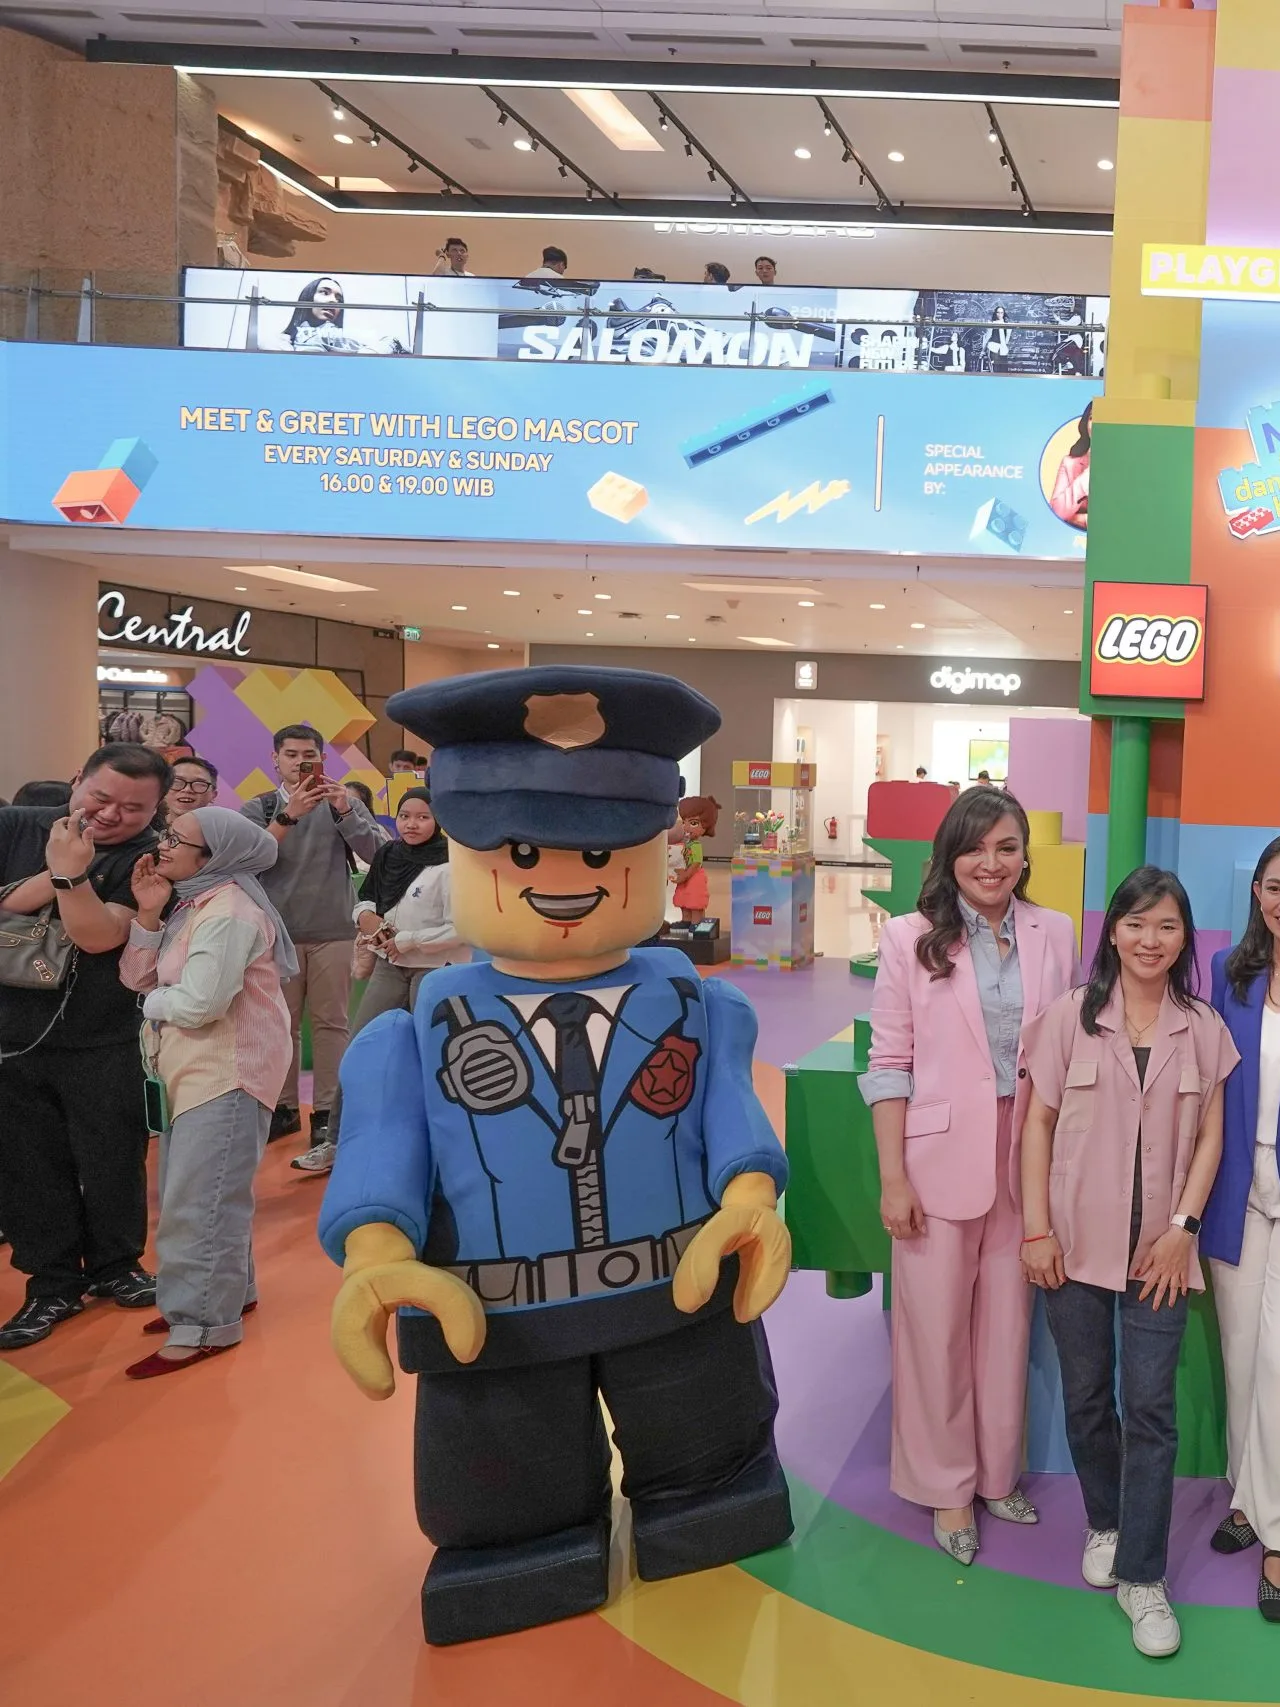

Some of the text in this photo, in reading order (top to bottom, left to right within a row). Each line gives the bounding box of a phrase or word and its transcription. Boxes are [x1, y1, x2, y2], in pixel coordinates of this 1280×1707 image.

[518, 325, 814, 367] SALOMON
[180, 406, 639, 445] MEET & GREET WITH LEGO MASCOT
[264, 443, 553, 473] EVERY SATURDAY & SUNDAY
[925, 444, 985, 459] SPECIAL
[320, 472, 495, 498] 16.00 & 19.00 WIB
[924, 463, 1024, 479] APPEARANCE
[924, 481, 946, 495] BY:
[97, 590, 251, 657] Central
[1096, 614, 1202, 665] LEGO
[929, 665, 1022, 695] digimap
[750, 768, 770, 779] LEGO
[755, 911, 771, 920] LEGO
